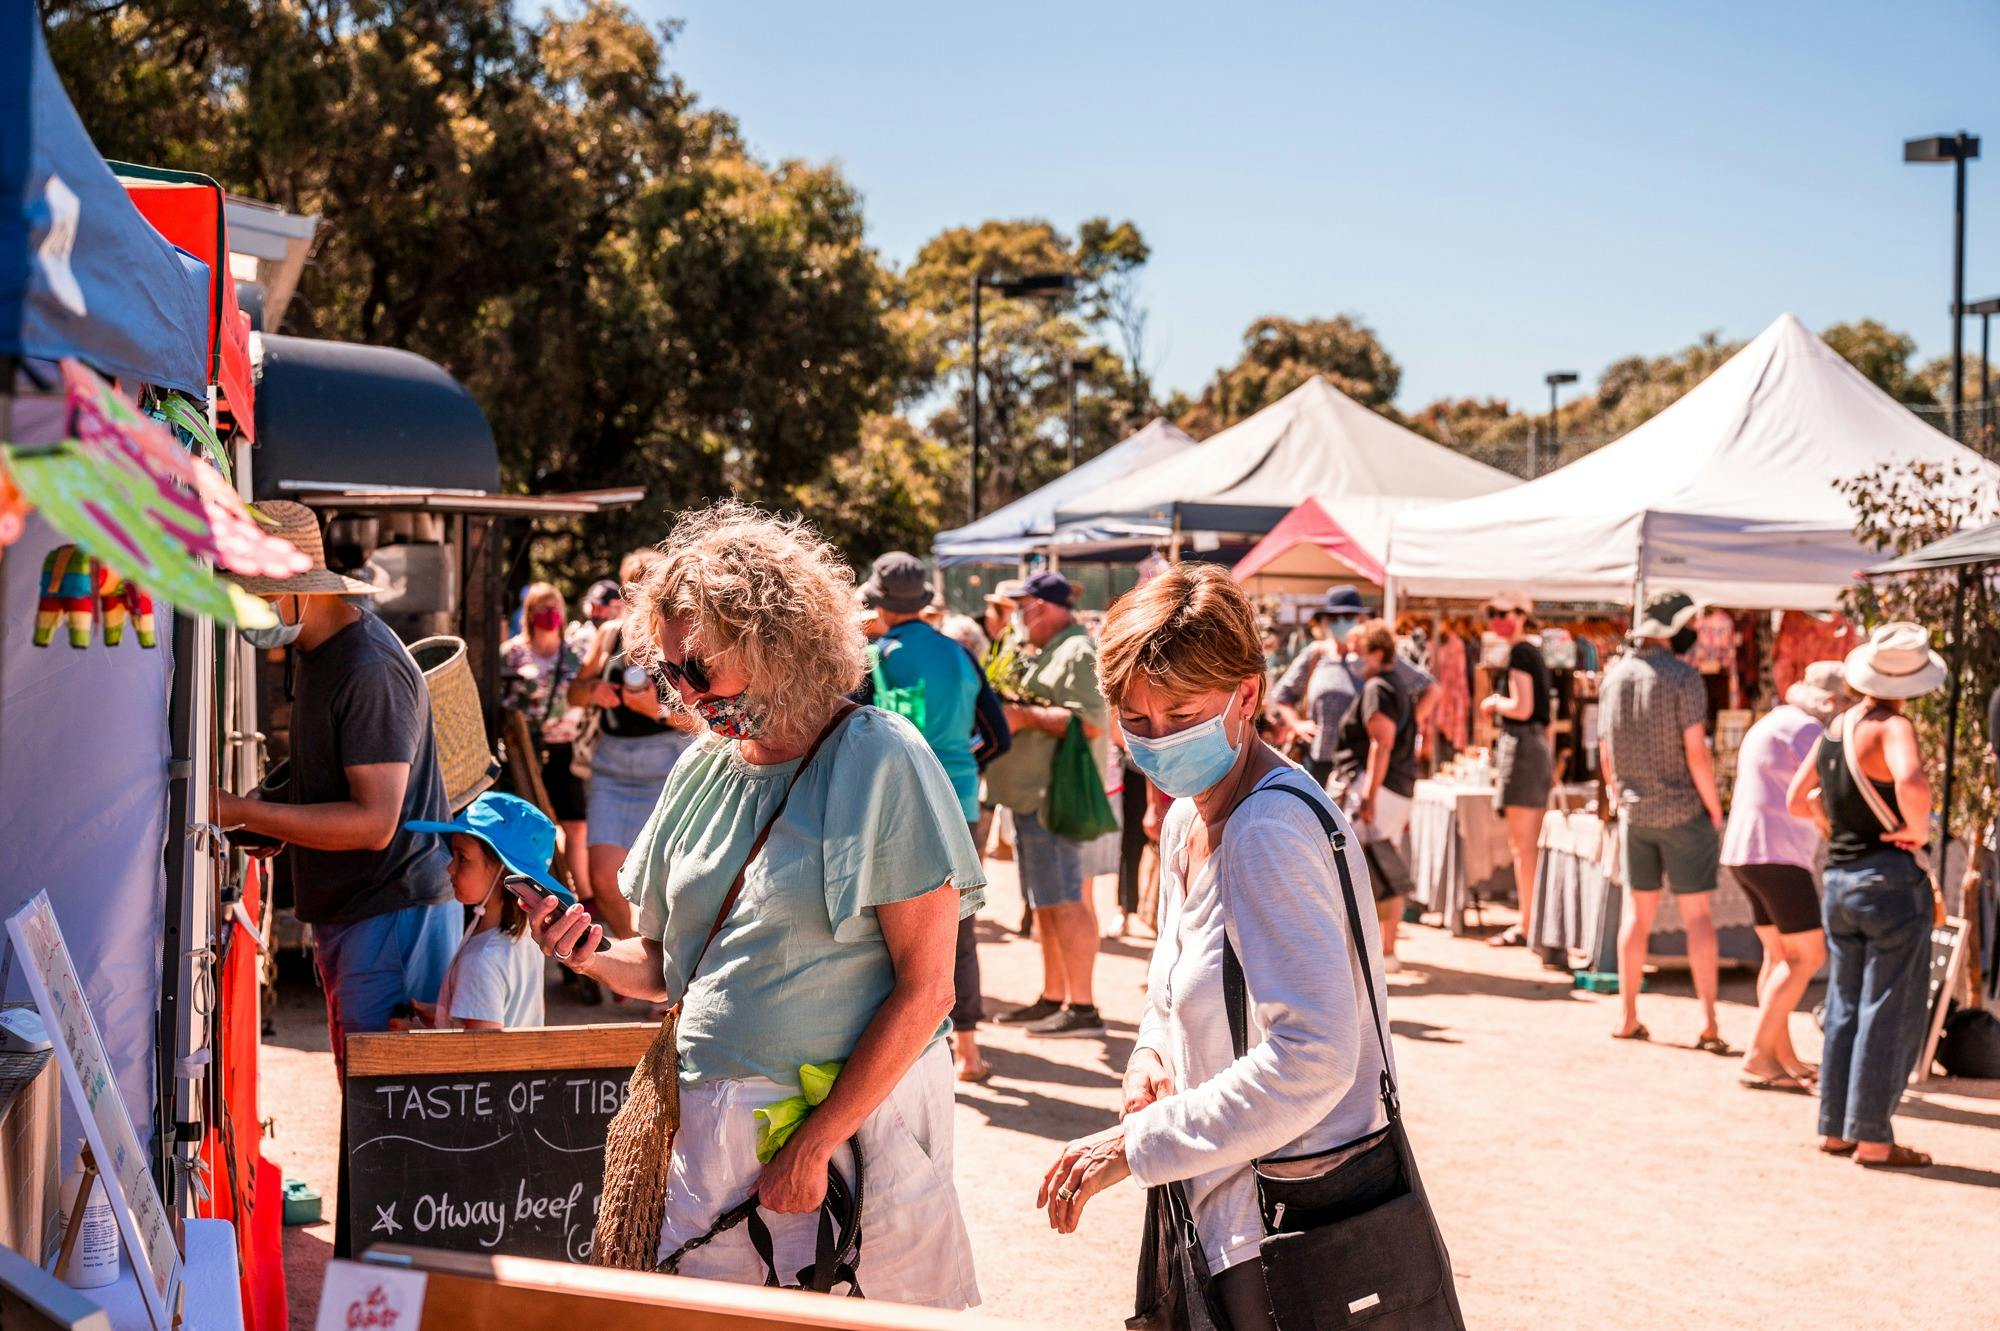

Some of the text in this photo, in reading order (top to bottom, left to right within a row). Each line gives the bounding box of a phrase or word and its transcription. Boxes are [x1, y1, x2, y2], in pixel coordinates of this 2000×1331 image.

[375, 1081, 493, 1120] TASTE
[508, 1080, 546, 1115] OF
[413, 1178, 583, 1248] Otway beef
